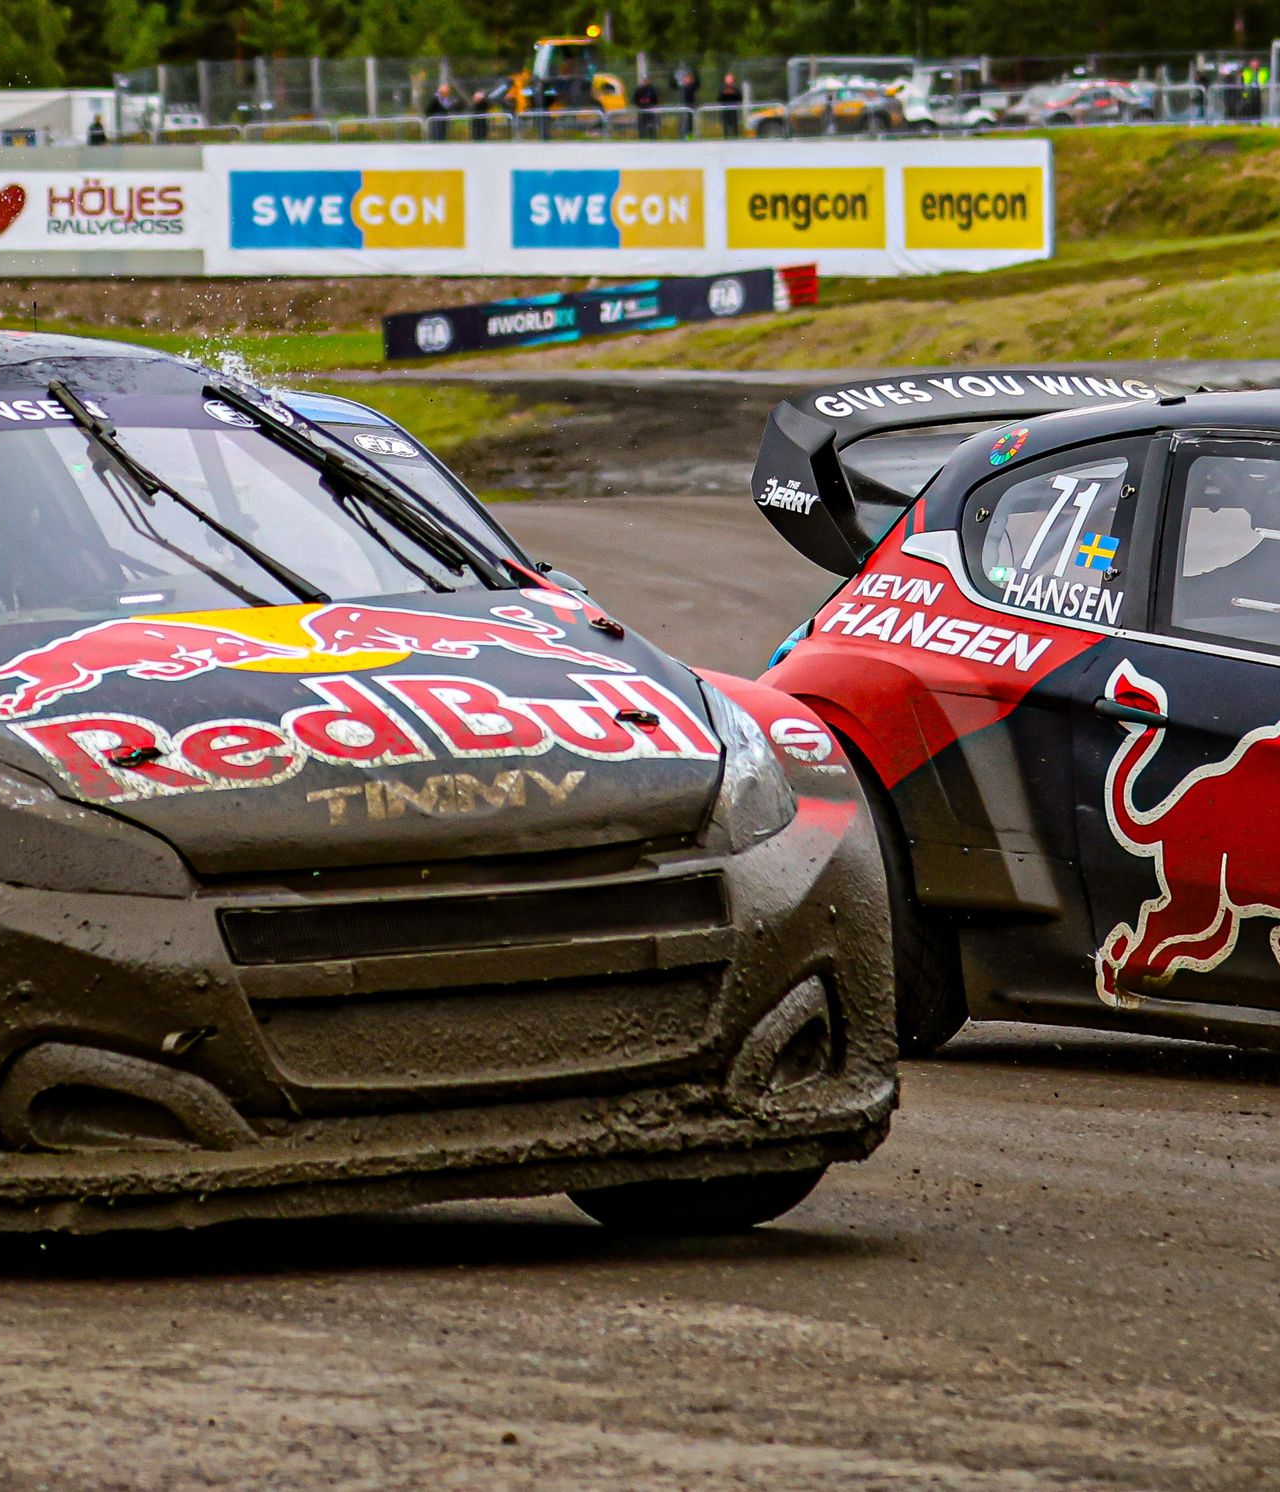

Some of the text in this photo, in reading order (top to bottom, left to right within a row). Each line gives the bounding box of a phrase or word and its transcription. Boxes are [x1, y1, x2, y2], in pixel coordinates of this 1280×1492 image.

[47, 218, 183, 234] RALLYCROSS
[747, 187, 868, 230] engcon
[920, 189, 1027, 230] engcon
[488, 308, 575, 336] #WORLDRX
[814, 382, 933, 418] GIVES
[927, 374, 1027, 400] YOU
[1021, 474, 1102, 578] 71
[852, 573, 945, 606] KEVIN
[1002, 570, 1124, 626] HANSEN
[820, 602, 1052, 672] HANSEN
[6, 674, 724, 803] Red Bull
[307, 769, 587, 826] TIMMY
